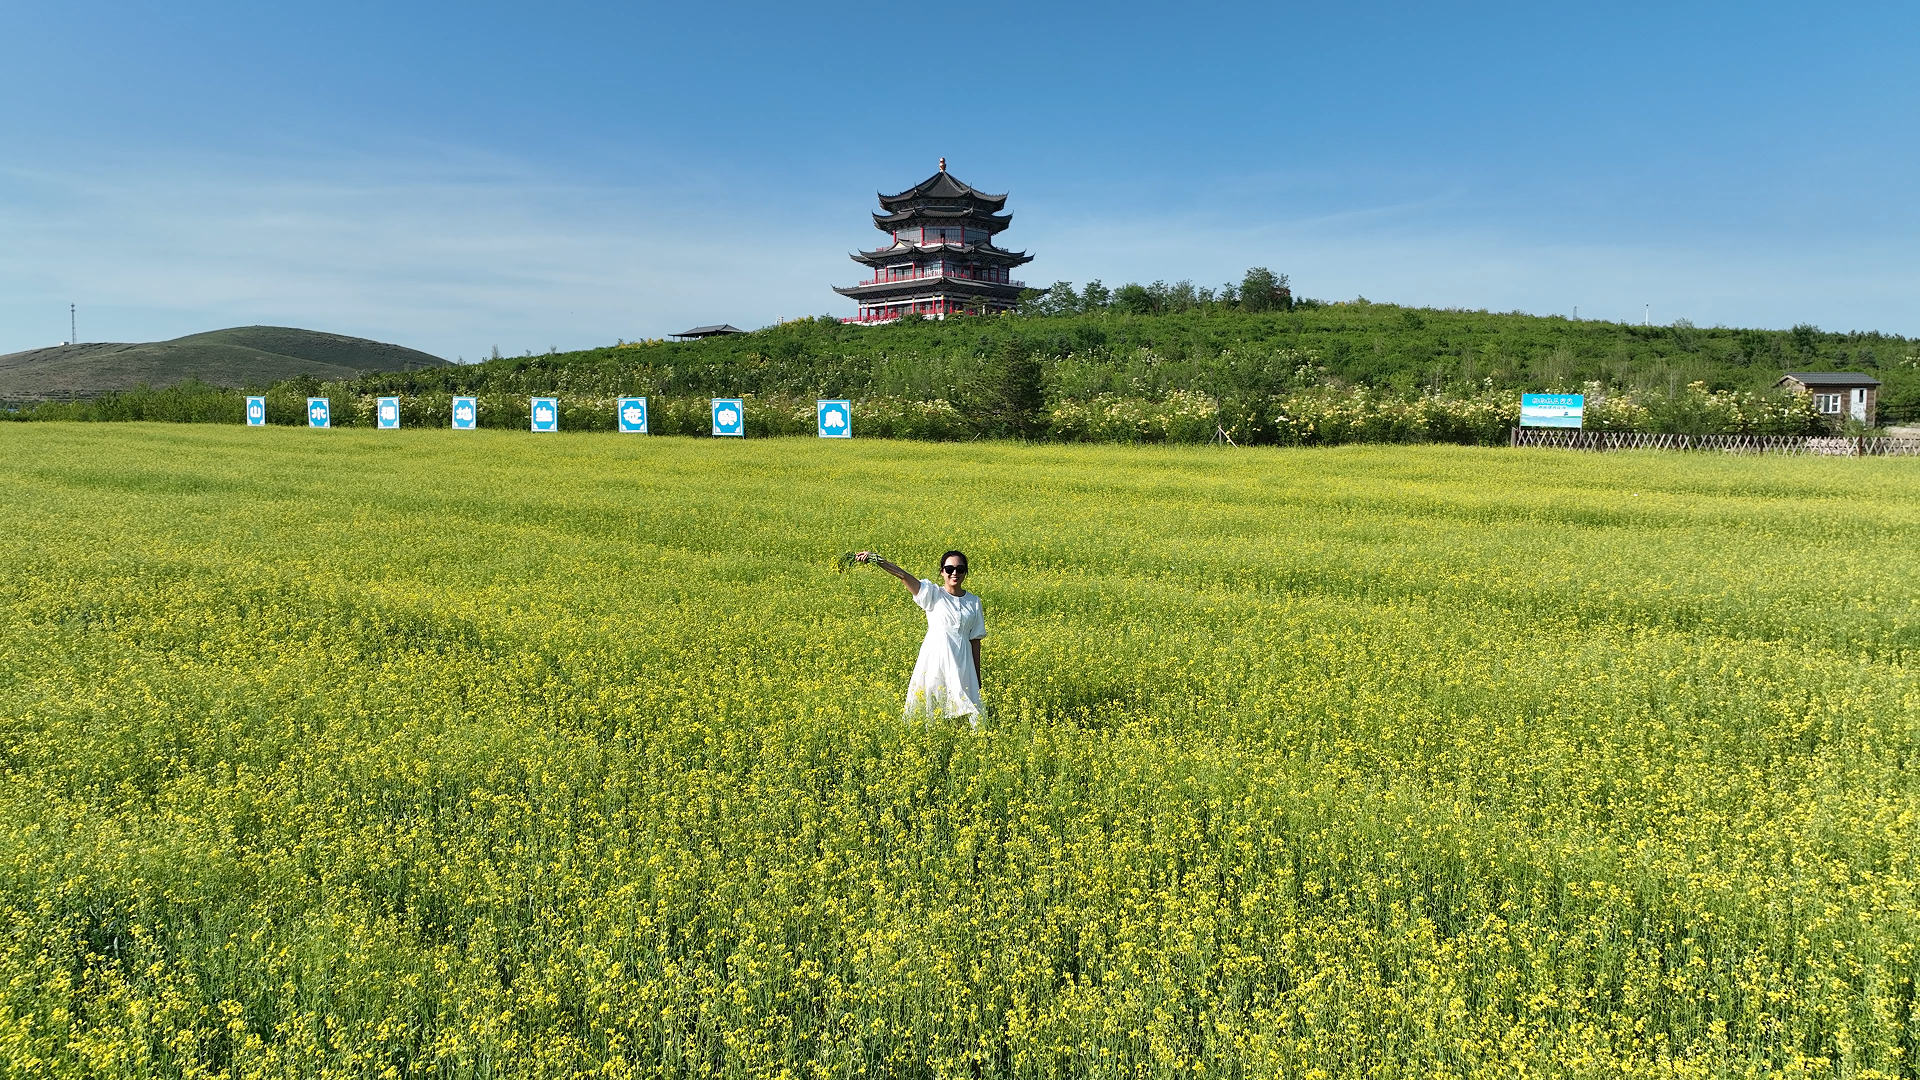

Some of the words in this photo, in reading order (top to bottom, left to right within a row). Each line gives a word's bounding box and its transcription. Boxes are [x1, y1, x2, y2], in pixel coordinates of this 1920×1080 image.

[249, 406, 261, 418] 山
[311, 407, 326, 421] 水
[380, 407, 395, 421] 福
[455, 406, 473, 421] 地
[535, 406, 553, 422] 生
[823, 410, 845, 428] 泉
